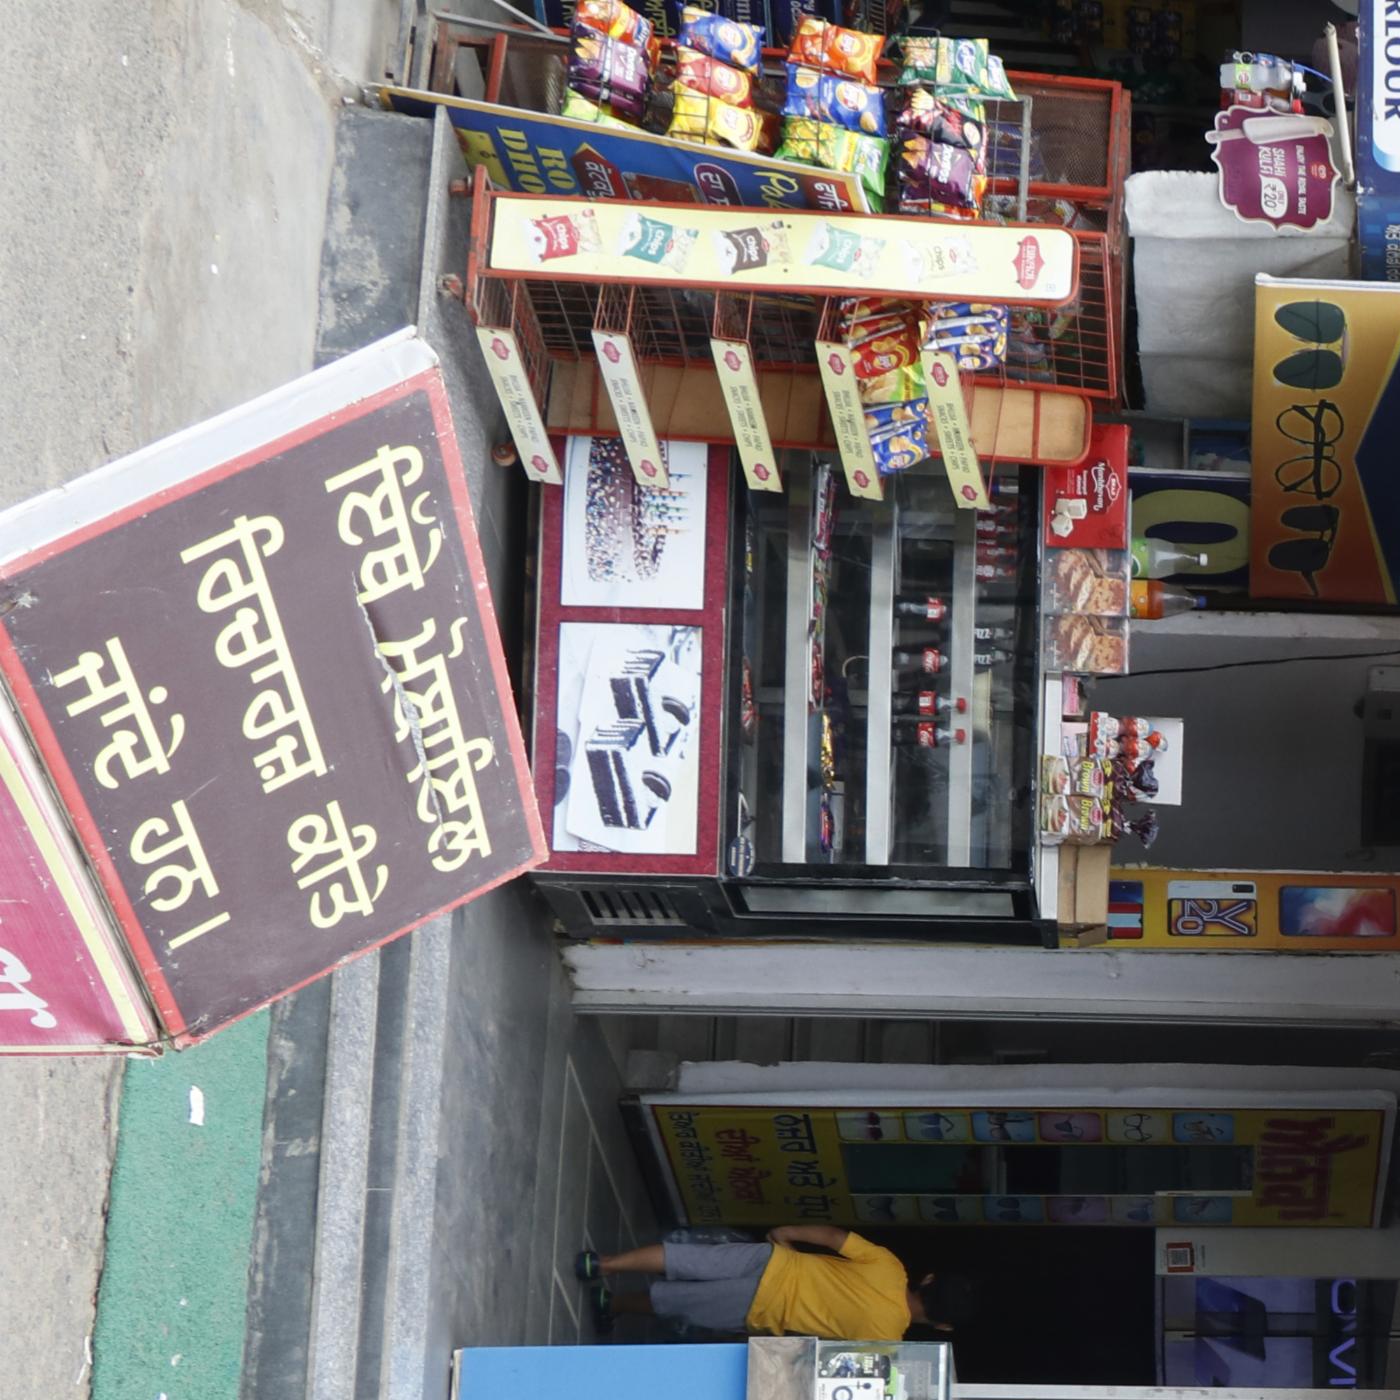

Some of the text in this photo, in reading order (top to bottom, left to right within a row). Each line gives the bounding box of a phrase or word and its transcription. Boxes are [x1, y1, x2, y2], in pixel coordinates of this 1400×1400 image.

[496, 126, 547, 194] DHO
[1258, 146, 1272, 175] KULFI
[1272, 148, 1286, 177] SHAHI
[556, 223, 569, 249] Chips
[648, 229, 664, 255] Chips
[746, 235, 759, 262] Chips
[50, 636, 186, 789] ਜਾਂਦੇ
[1081, 761, 1094, 792] Brown
[286, 800, 389, 928] ਕੀਤੇ
